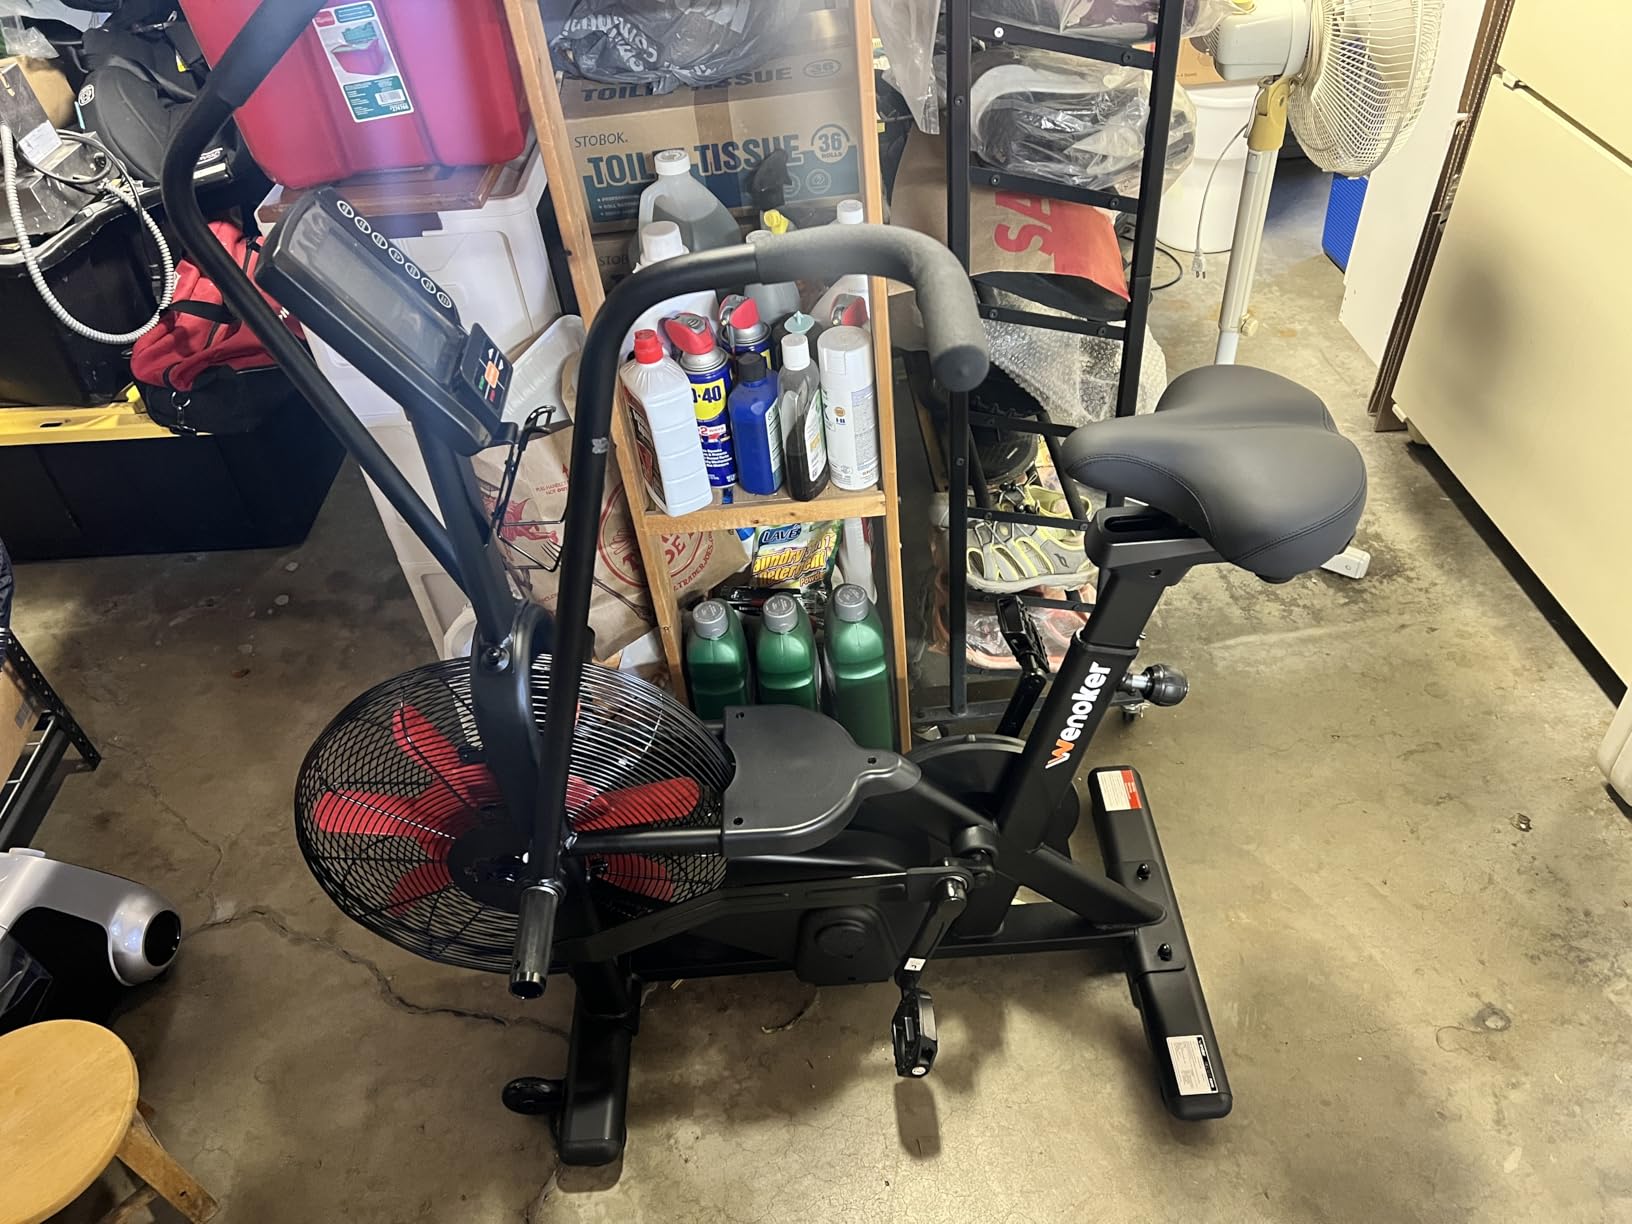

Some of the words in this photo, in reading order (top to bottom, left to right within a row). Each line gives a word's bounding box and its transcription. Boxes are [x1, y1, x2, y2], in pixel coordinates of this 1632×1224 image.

[581, 83, 655, 102] TOIL
[818, 132, 843, 153] 36
[821, 151, 842, 159] ROLLS
[586, 149, 684, 186] TOIL
[752, 548, 804, 573] aundry
